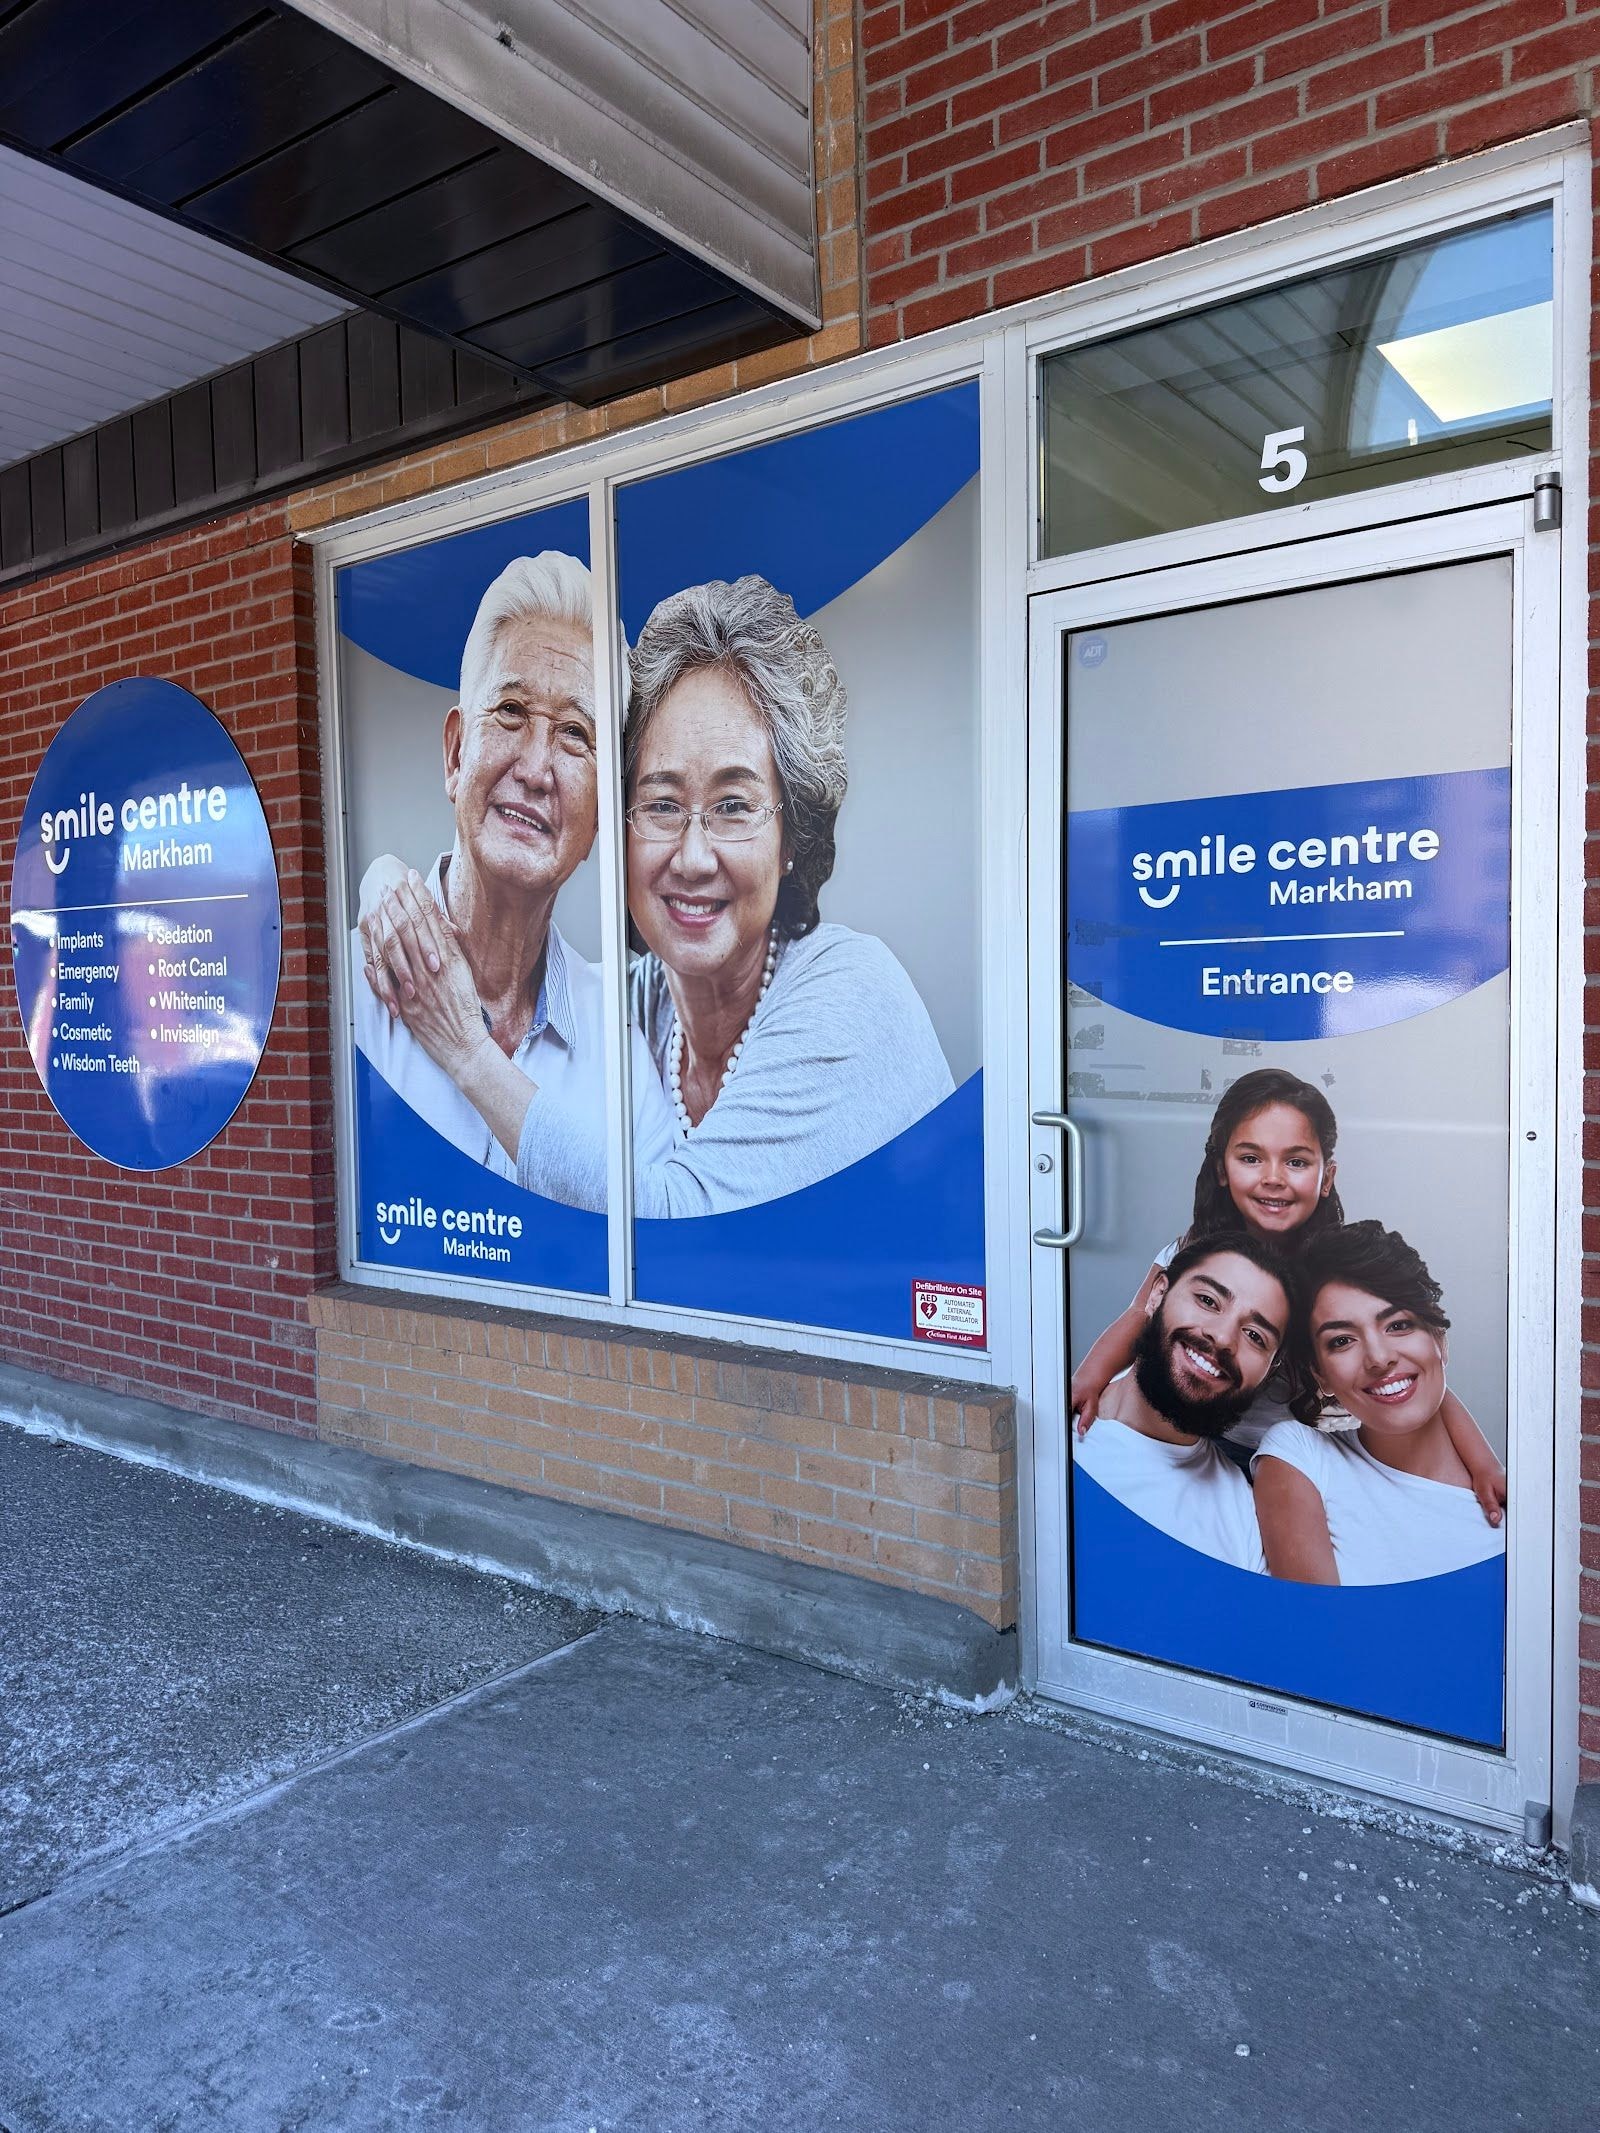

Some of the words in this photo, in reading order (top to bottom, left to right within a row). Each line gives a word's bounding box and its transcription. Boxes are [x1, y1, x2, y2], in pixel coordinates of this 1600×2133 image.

[1259, 426, 1307, 493] 5
[1083, 645, 1104, 659] ADT
[40, 792, 114, 843] smile
[121, 782, 227, 832] centre
[124, 839, 212, 872] Markham
[1132, 834, 1256, 881] smile
[1267, 825, 1440, 870] centre
[1269, 875, 1413, 905] Markham
[57, 932, 104, 950] Implants
[157, 924, 213, 945] Sedation
[58, 963, 119, 983] Emergency
[158, 960, 187, 978] Root
[189, 957, 227, 977] Canal
[1202, 966, 1354, 996] Entrance
[59, 992, 95, 1014] Family
[159, 991, 225, 1015] Whitening
[60, 1023, 112, 1042] Cosmetic
[160, 1024, 219, 1048] Invisalign
[61, 1053, 107, 1073] Wisdom
[108, 1054, 140, 1074] Teeth
[376, 1197, 437, 1228] smile
[442, 1208, 523, 1239] centre
[443, 1236, 511, 1262] Markham
[915, 1282, 956, 1293] Defibrillator
[957, 1287, 968, 1295] On
[968, 1288, 982, 1297] Site
[920, 1293, 938, 1303] AED
[943, 1299, 976, 1309] AUTOMATED
[947, 1307, 972, 1316] EXTERNAL
[941, 1314, 979, 1325] DEFIBRILLATOR
